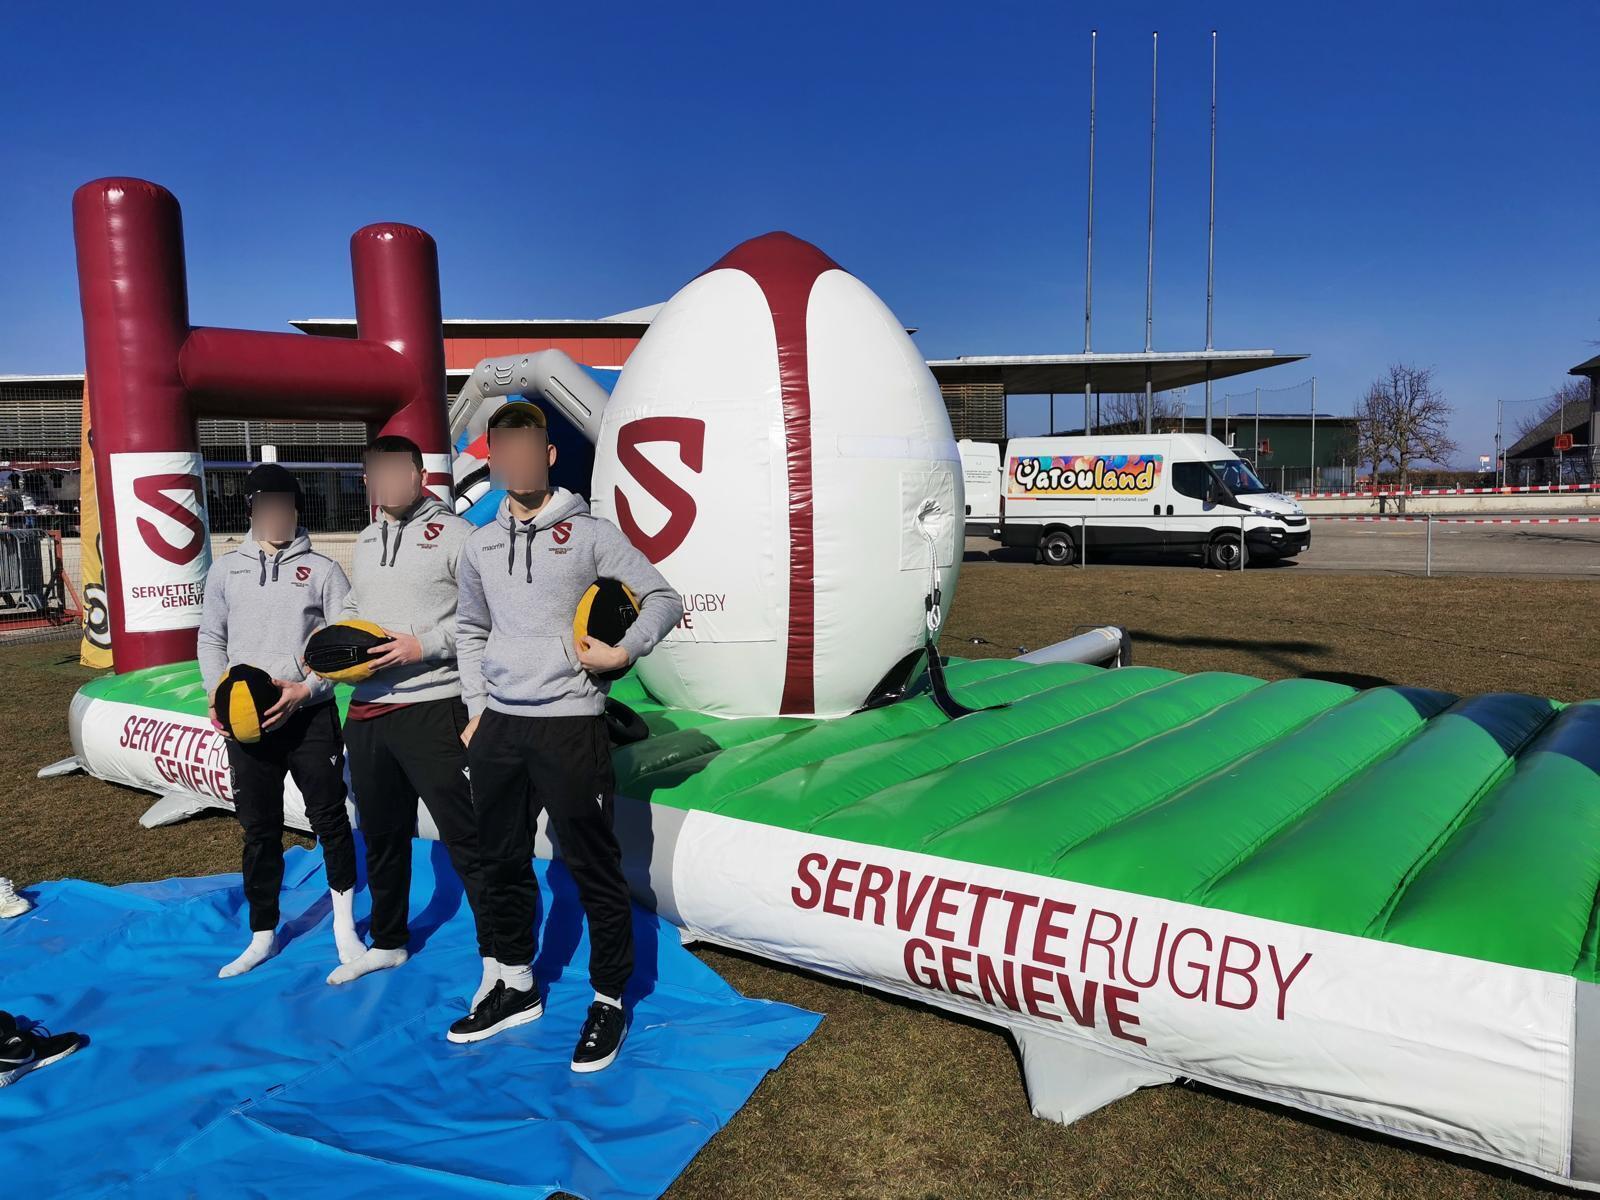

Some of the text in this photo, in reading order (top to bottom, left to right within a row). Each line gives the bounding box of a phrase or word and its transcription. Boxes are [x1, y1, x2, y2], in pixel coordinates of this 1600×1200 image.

[131, 583, 195, 599] SERVETTE
[679, 593, 726, 612] UGBY
[119, 714, 214, 765] SERVETTE
[790, 852, 1314, 1021] SERVETTE RUGBY
[903, 937, 1148, 1047] GENEVE
